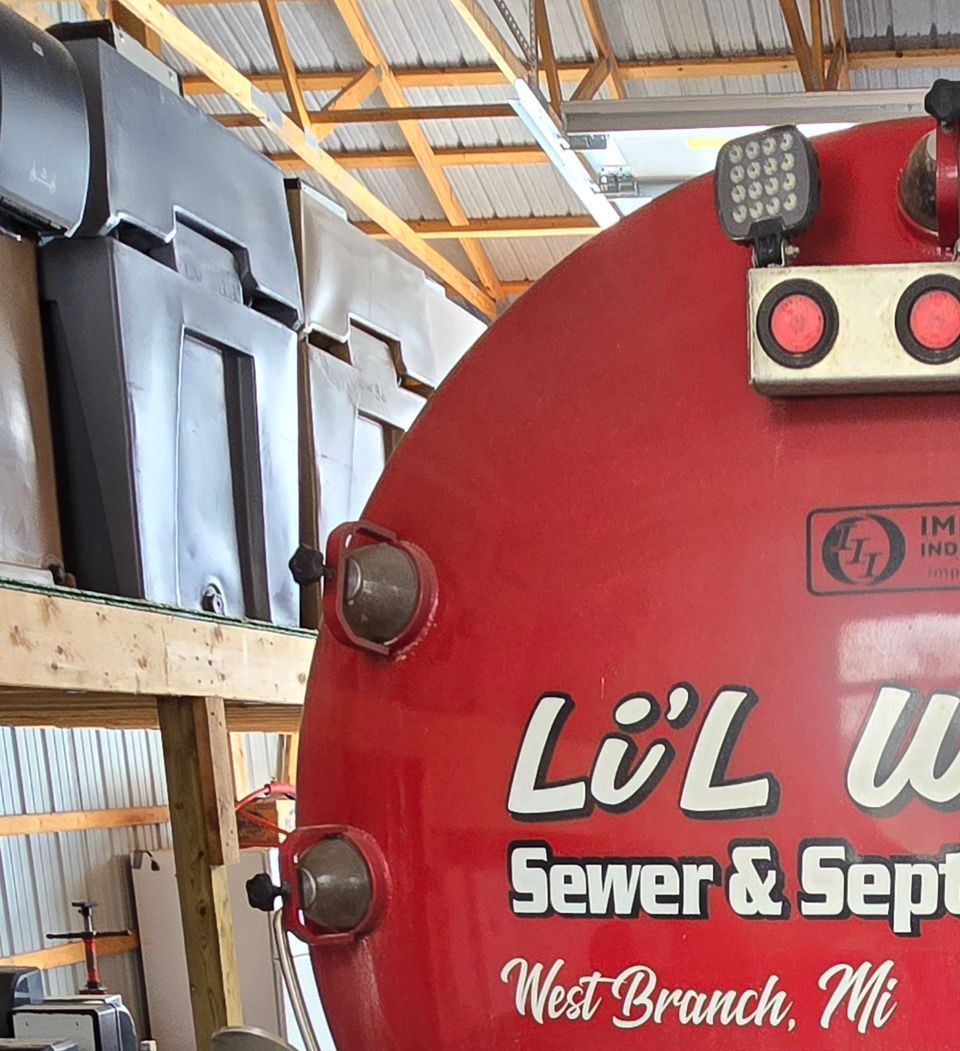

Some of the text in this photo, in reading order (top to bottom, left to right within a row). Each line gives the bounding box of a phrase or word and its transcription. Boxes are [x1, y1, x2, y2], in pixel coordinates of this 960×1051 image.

[505, 682, 779, 820] Li'L
[507, 840, 720, 919] Sewer
[726, 841, 789, 919] &
[500, 957, 899, 1034] West Branch, Mi
